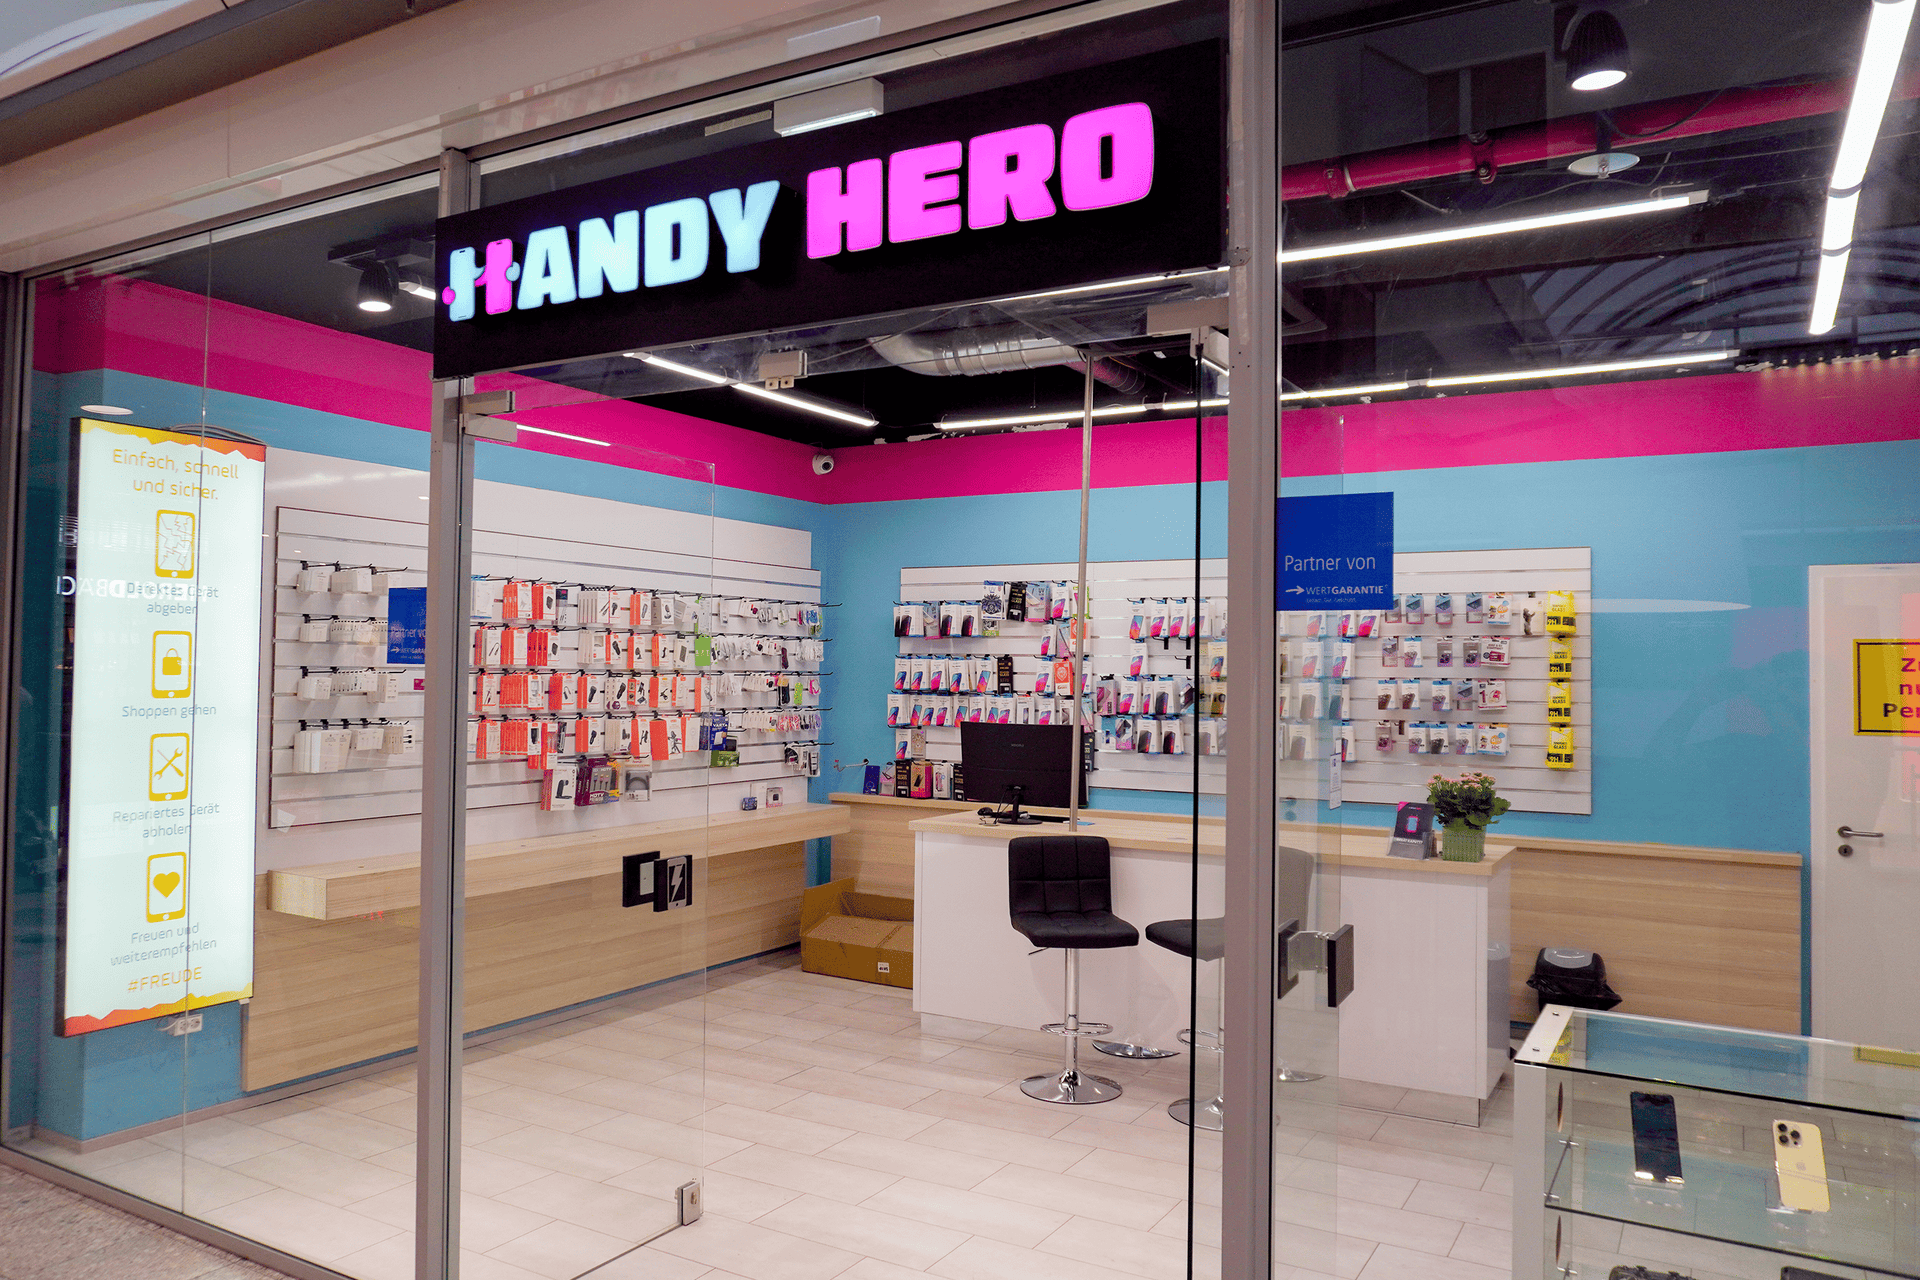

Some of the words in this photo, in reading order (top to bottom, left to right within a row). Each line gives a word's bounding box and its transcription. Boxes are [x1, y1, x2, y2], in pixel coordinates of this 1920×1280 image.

[442, 179, 781, 322] HANDY
[805, 101, 1155, 260] HERO
[112, 448, 180, 473] Einfach,
[183, 459, 239, 480] schnell
[133, 477, 165, 496] und
[170, 481, 219, 501] sicher.
[1284, 555, 1341, 572] Partner
[1346, 556, 1376, 570] von
[1305, 585, 1384, 596] WERTGARANTIE
[1901, 658, 1920, 673] Z
[122, 704, 177, 719] Shoppen
[180, 703, 217, 718] gehen
[112, 806, 185, 824] Repariertes
[131, 927, 173, 944] Freuen
[176, 922, 200, 937] und
[110, 938, 217, 967] weiterempfehlen
[127, 966, 203, 994] #FREUDE
